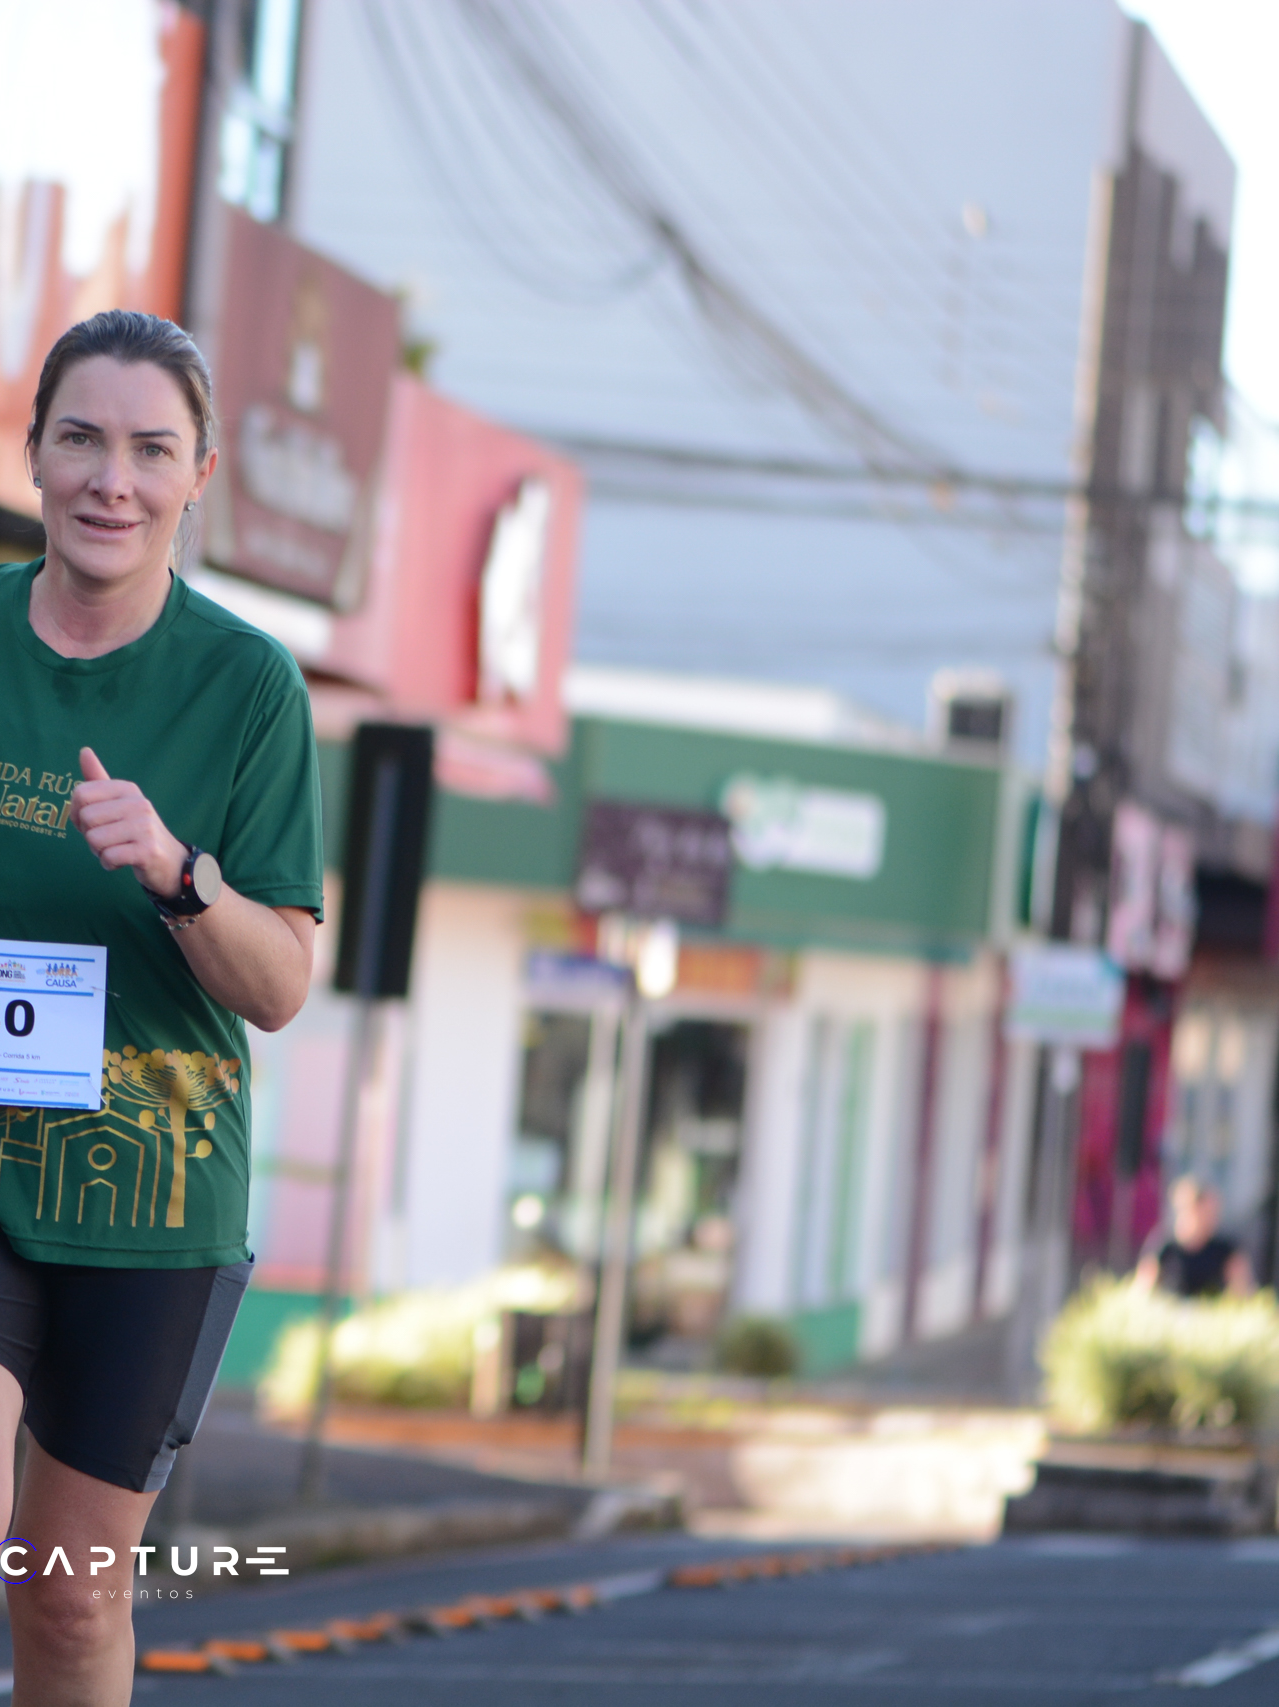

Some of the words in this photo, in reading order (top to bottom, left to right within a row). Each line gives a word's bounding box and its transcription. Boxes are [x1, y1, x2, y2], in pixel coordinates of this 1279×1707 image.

[19, 822, 30, 830] DO
[31, 825, 53, 836] OESTE
[57, 831, 67, 839] SC
[46, 978, 77, 988] CAUSA
[3, 1052, 25, 1060] Corrida
